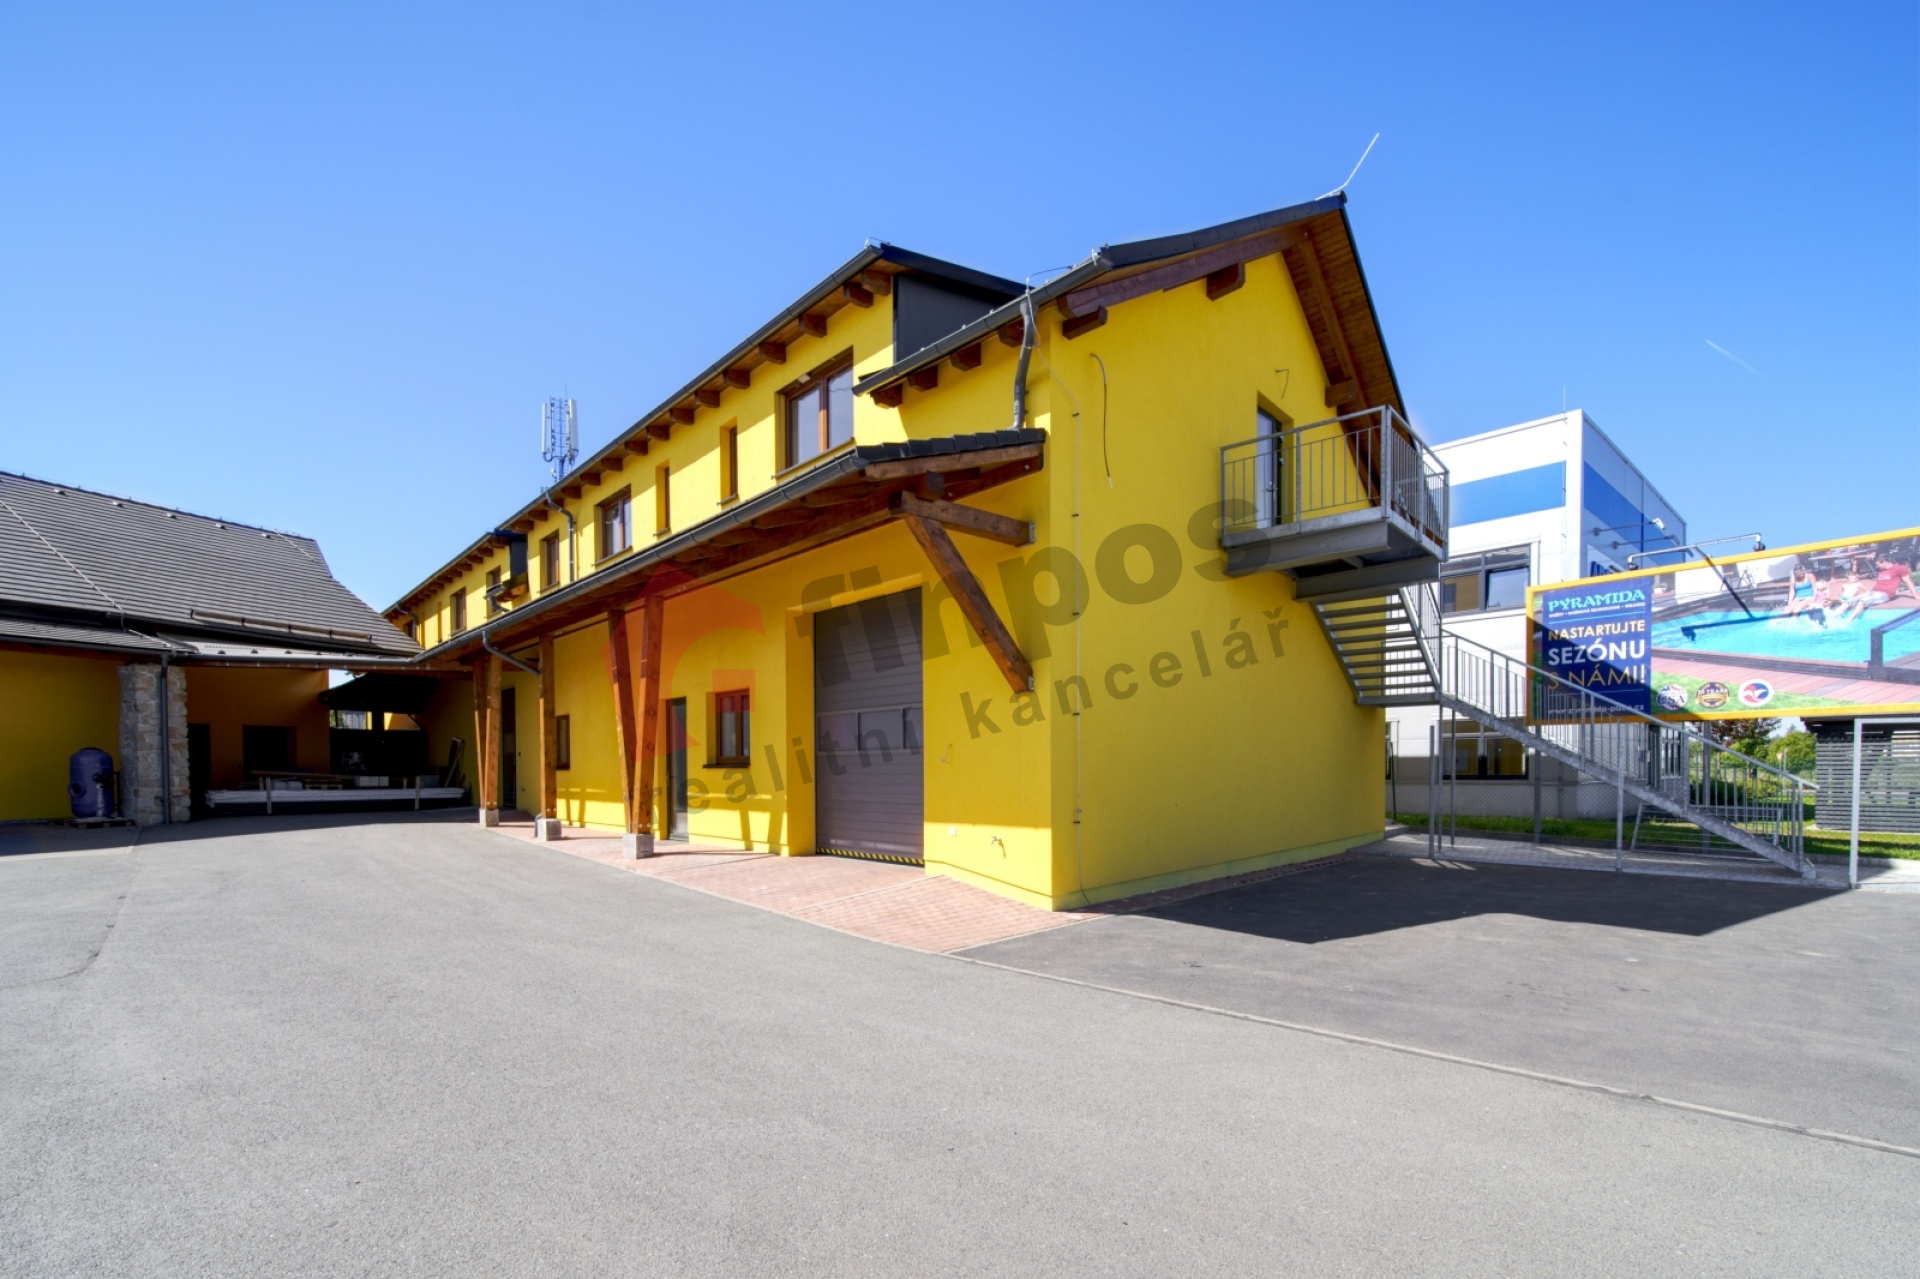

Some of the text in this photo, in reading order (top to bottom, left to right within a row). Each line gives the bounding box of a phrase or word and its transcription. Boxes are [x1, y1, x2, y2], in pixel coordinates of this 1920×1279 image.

[1548, 589, 1646, 612] PYRAMIDA
[1548, 620, 1646, 641] NASTARTUJTE
[1548, 638, 1646, 666] SEZÓNU
[1548, 663, 1646, 690] S NÁMI!
